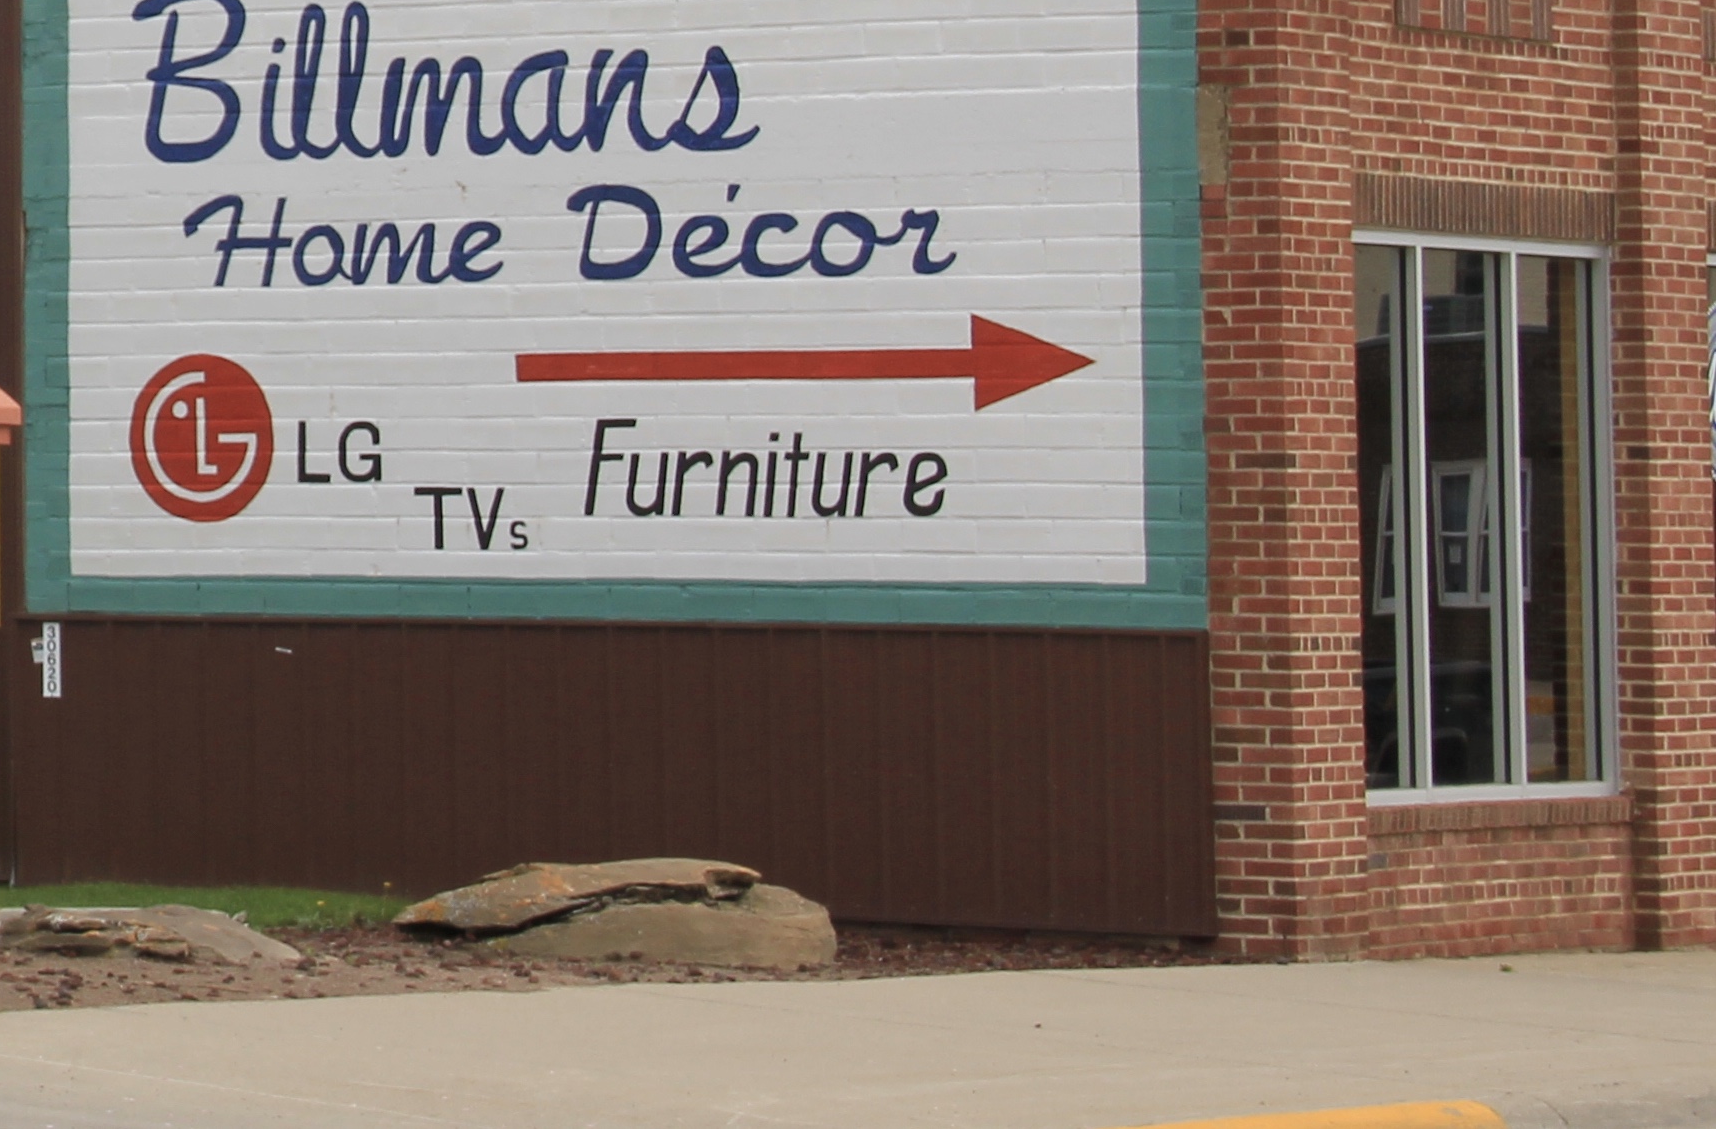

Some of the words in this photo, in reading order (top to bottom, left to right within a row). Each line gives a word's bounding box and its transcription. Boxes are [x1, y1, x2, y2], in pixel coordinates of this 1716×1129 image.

[182, 194, 504, 288] Home
[566, 184, 957, 281] Décor
[297, 421, 382, 484] LG
[584, 418, 948, 519] Furniture
[414, 486, 529, 551] TVs
[46, 624, 58, 694] 30620
